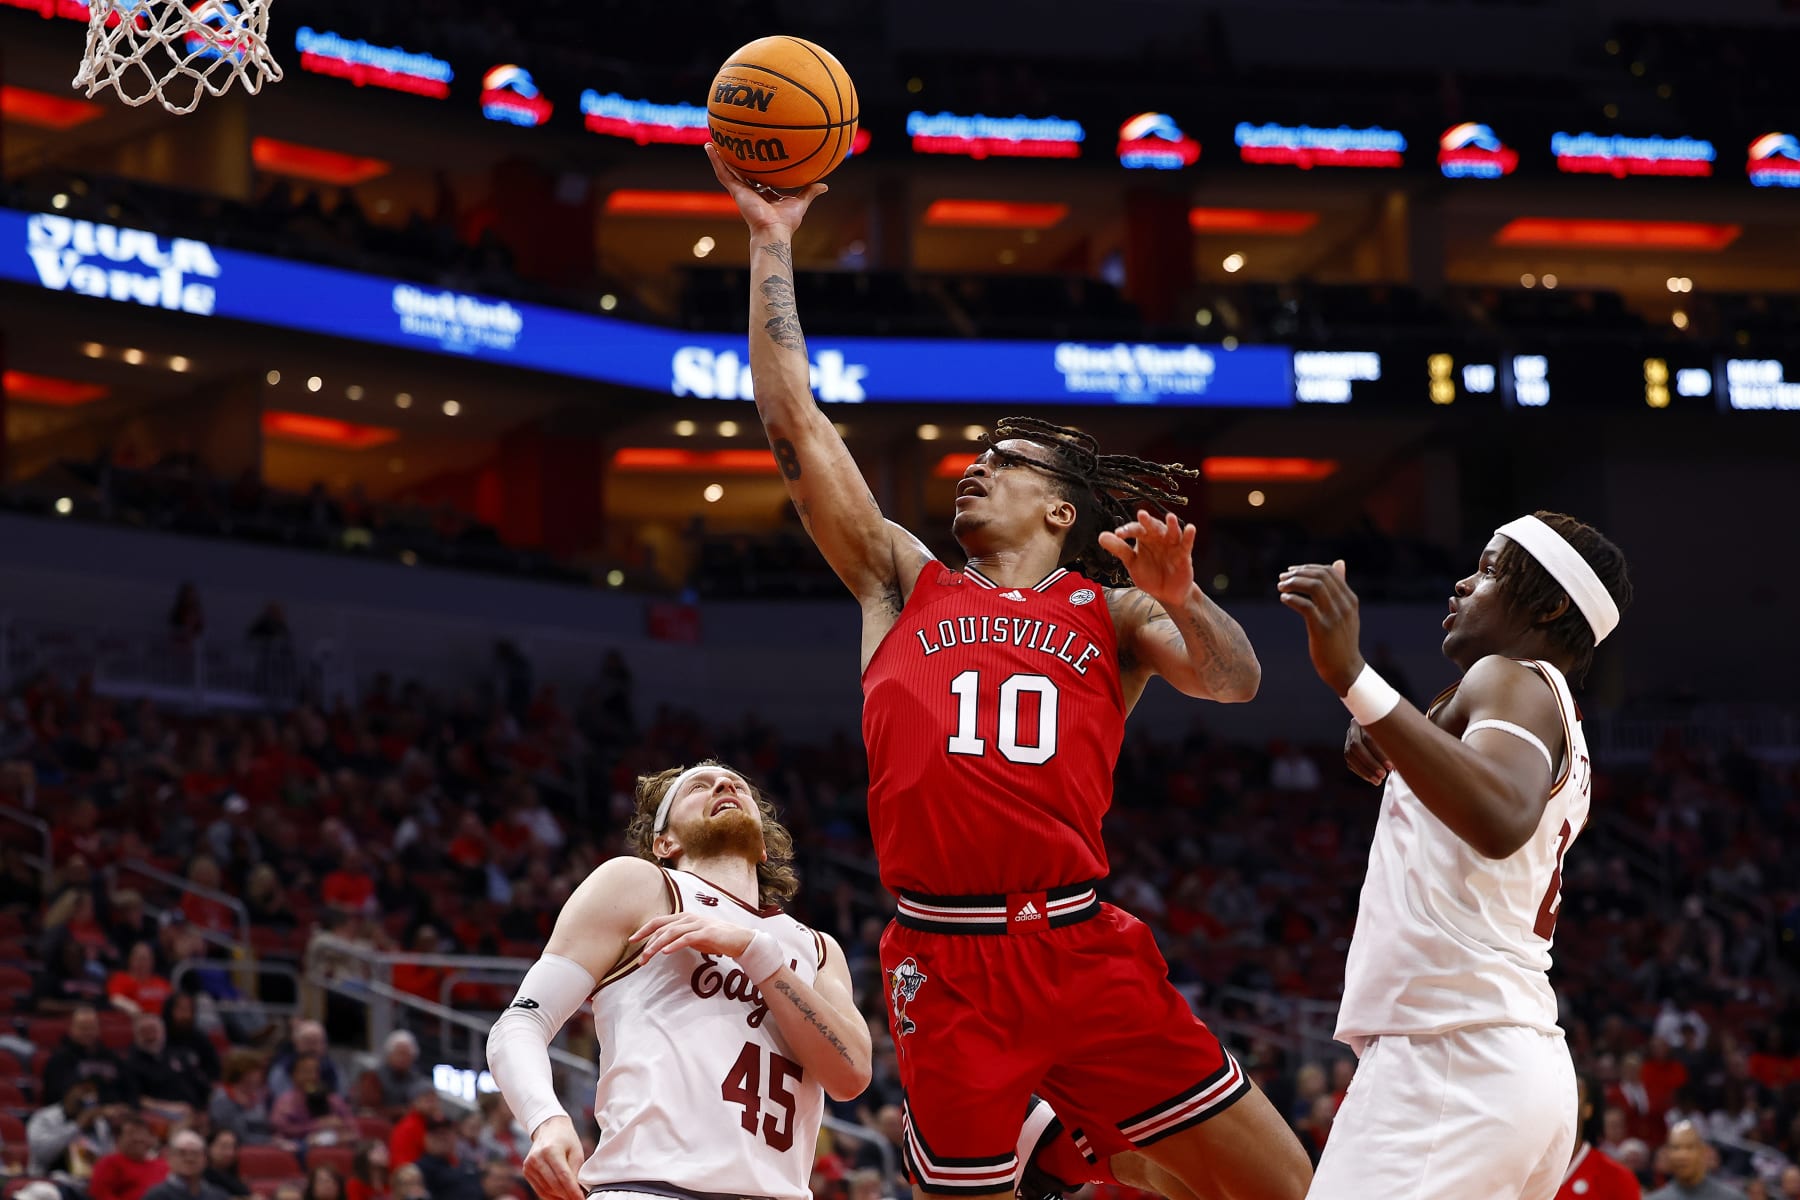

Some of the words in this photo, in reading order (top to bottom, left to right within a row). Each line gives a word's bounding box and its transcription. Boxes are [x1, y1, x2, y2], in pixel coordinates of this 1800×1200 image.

[714, 83, 775, 112] NCAA
[711, 127, 789, 162] Wilson
[916, 616, 1101, 675] LOUISVILLE
[947, 669, 1059, 765] 10
[1015, 913, 1042, 922] adidas
[721, 1041, 804, 1153] 45
